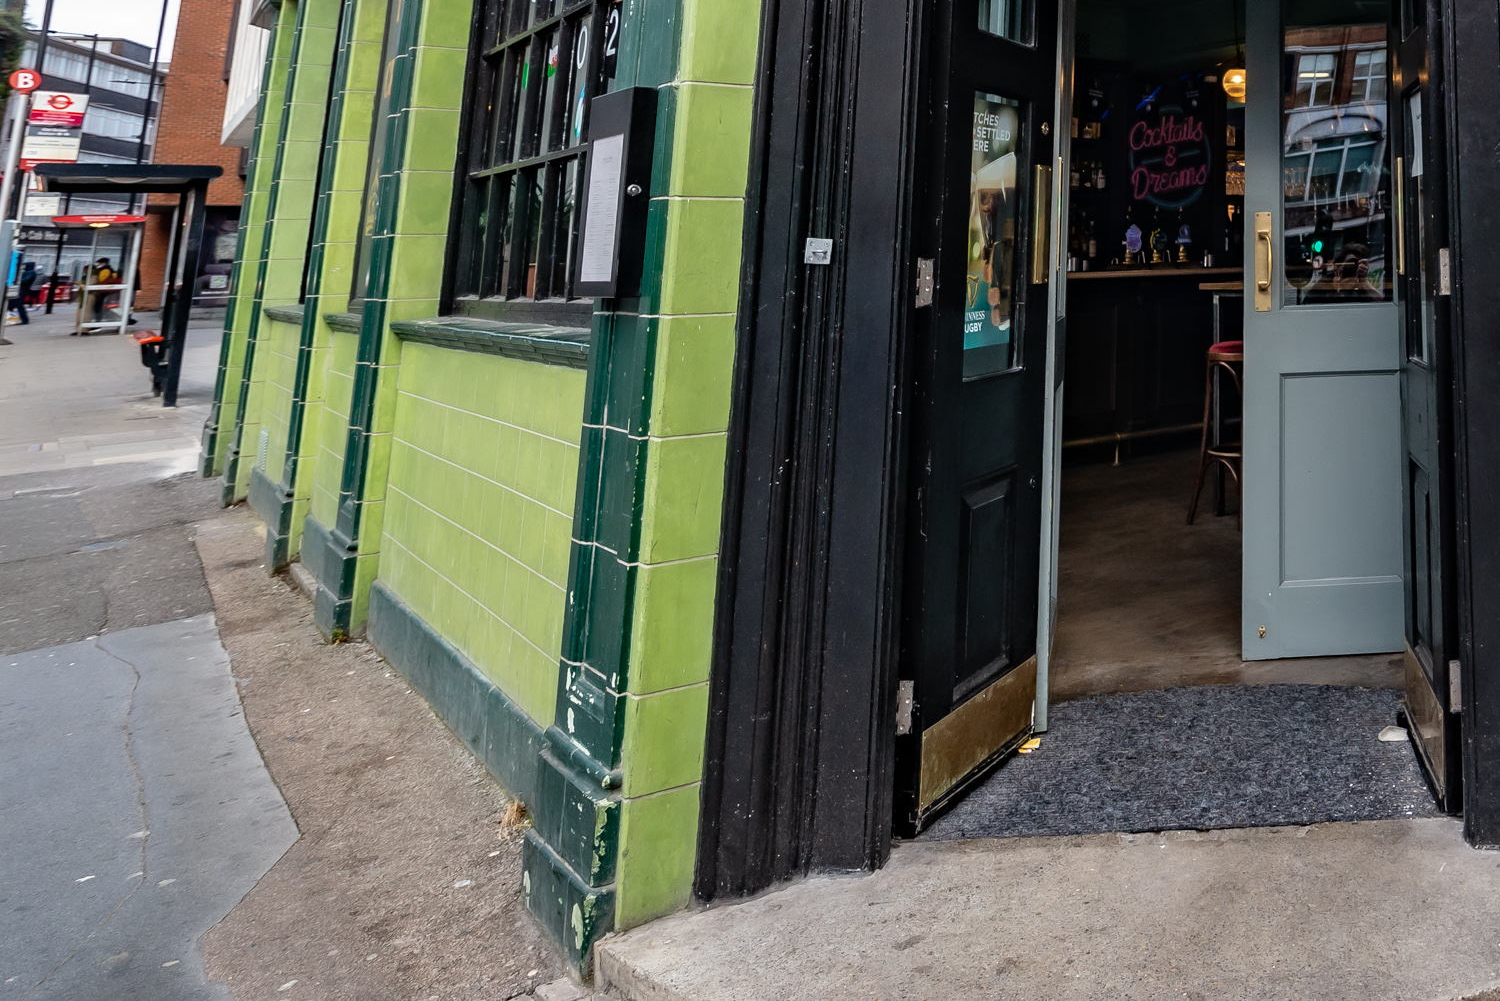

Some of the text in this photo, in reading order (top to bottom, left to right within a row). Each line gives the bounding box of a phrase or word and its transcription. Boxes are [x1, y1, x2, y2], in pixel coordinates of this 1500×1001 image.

[17, 72, 35, 89] B
[976, 126, 1011, 142] SETTLED
[1130, 115, 1204, 151] Cocktails
[1164, 145, 1177, 167] &
[1131, 164, 1208, 201] Dreams
